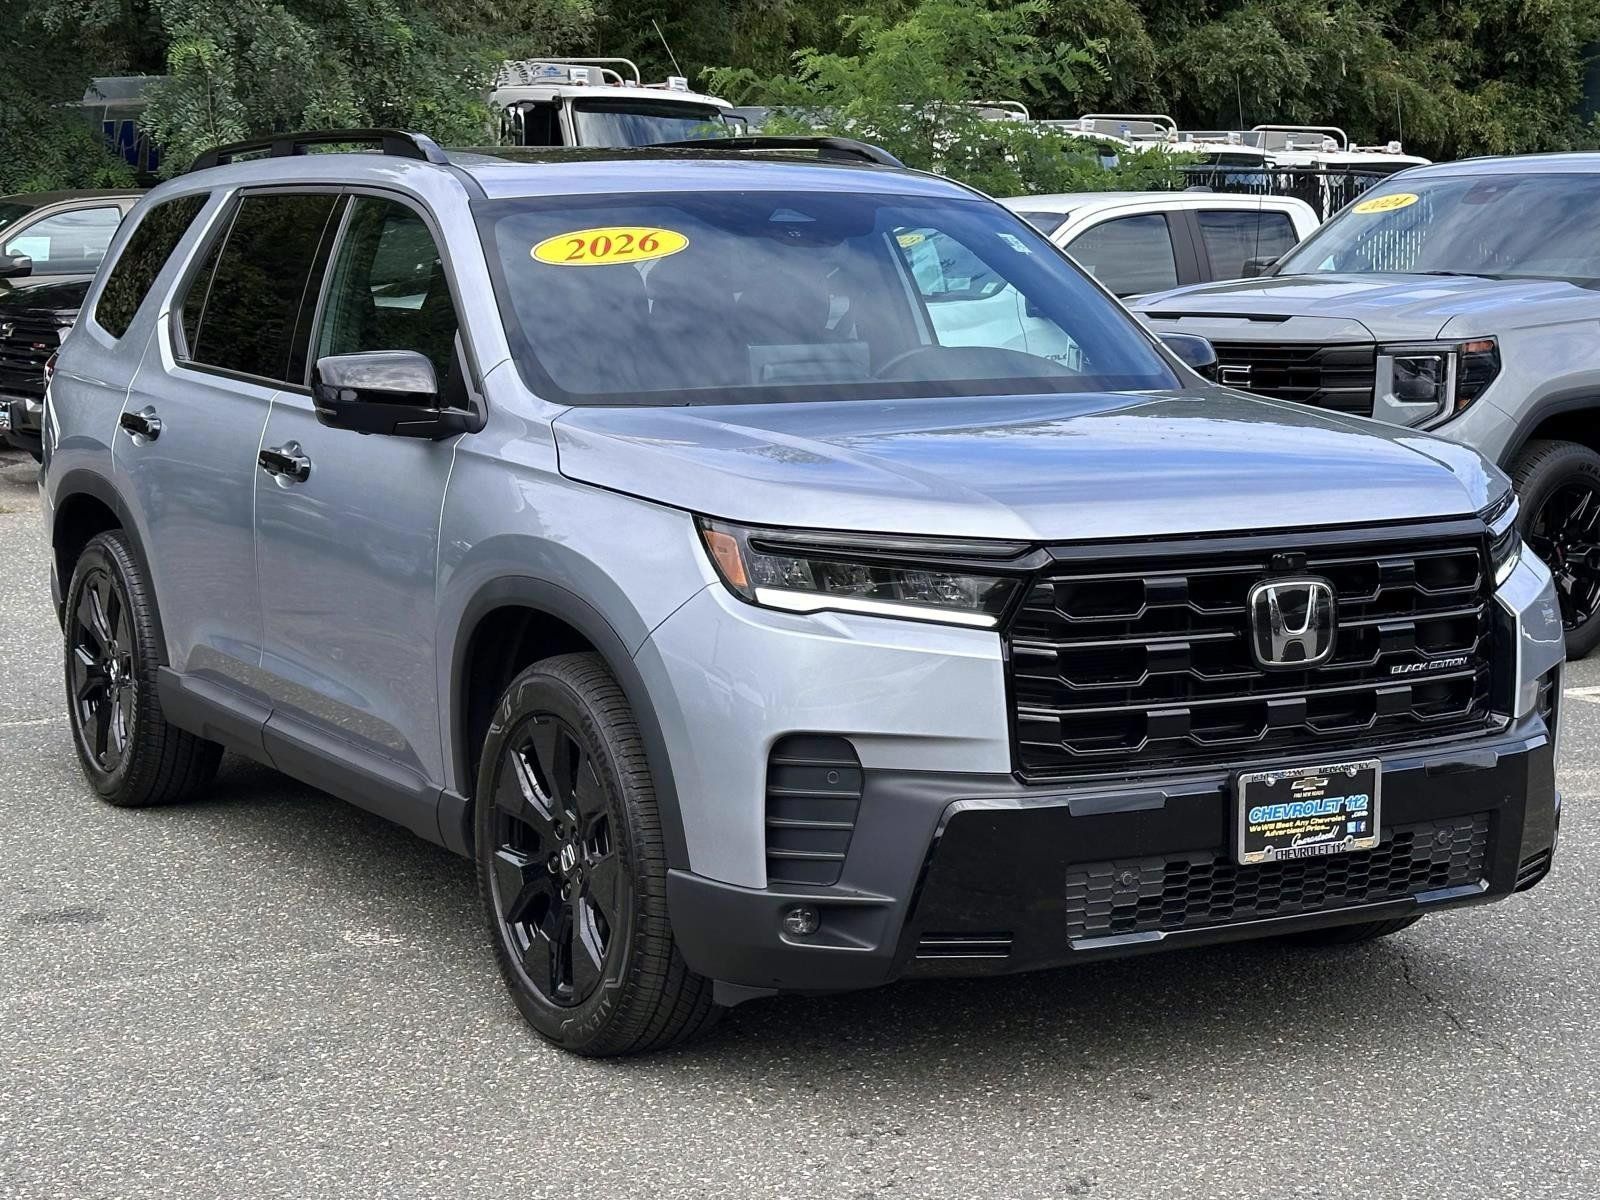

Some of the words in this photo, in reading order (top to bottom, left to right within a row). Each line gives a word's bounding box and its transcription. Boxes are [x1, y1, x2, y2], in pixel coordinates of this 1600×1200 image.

[564, 231, 661, 262] 2026
[1391, 662, 1428, 675] BLACK
[1429, 656, 1468, 670] EDITION
[1249, 797, 1345, 823] CHEVROLET
[1345, 794, 1368, 811] 112
[1275, 844, 1329, 860] CHEVROLET
[1331, 842, 1346, 854] 112
